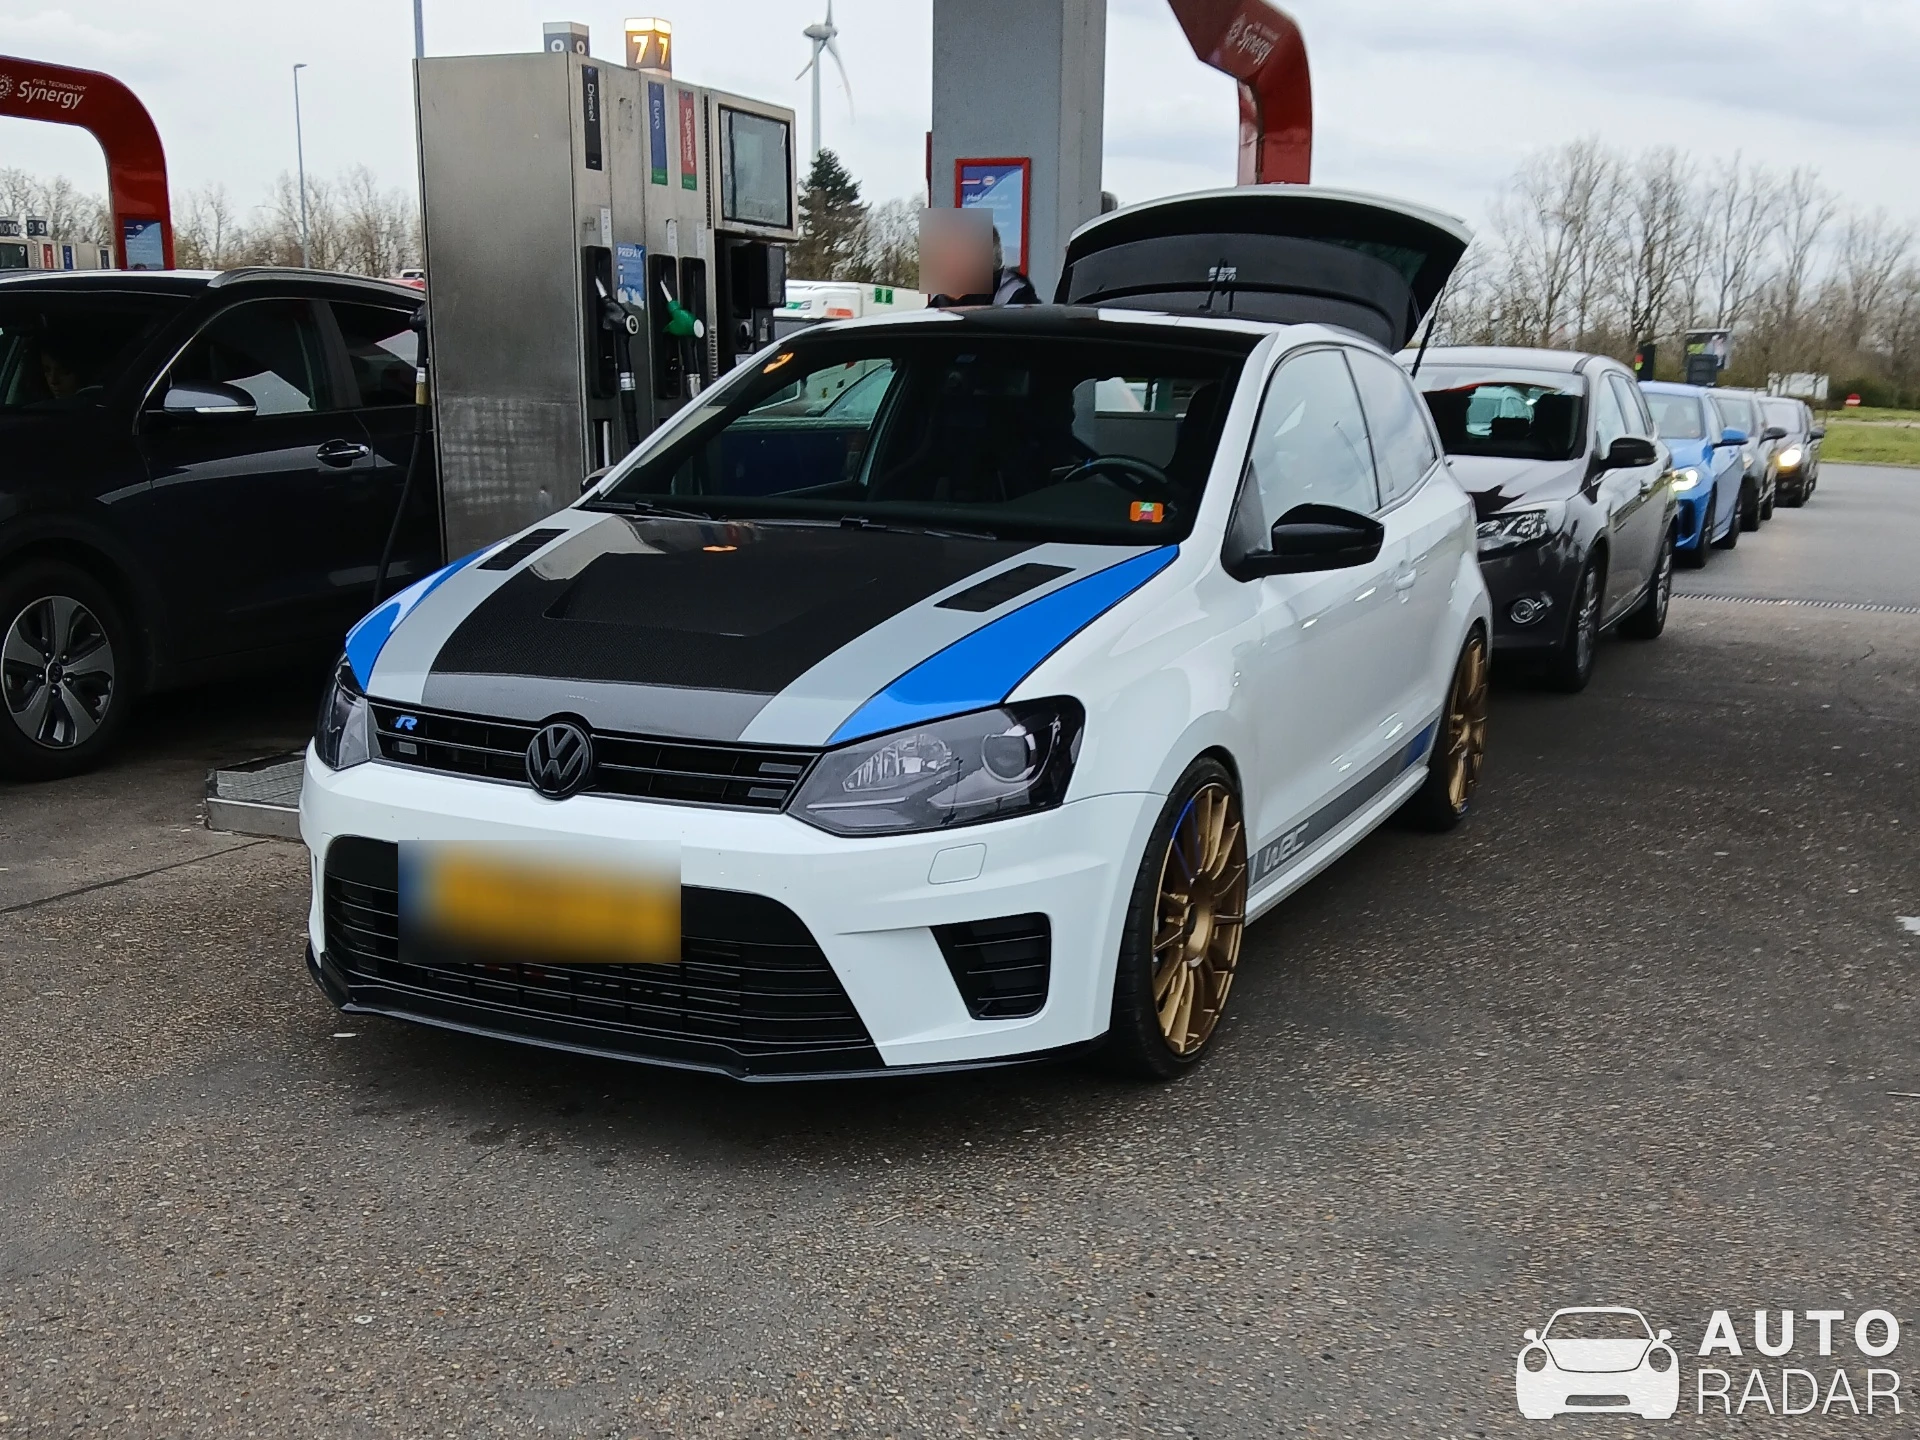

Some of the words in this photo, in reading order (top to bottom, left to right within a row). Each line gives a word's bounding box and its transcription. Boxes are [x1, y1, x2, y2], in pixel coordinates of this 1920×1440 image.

[632, 35, 649, 64] 7
[658, 36, 668, 65] 7
[17, 81, 84, 110] Synergy
[587, 83, 596, 122] Diesel
[653, 99, 661, 130] Euro
[38, 222, 45, 234] 9
[19, 246, 26, 257] 9
[395, 715, 418, 730] R
